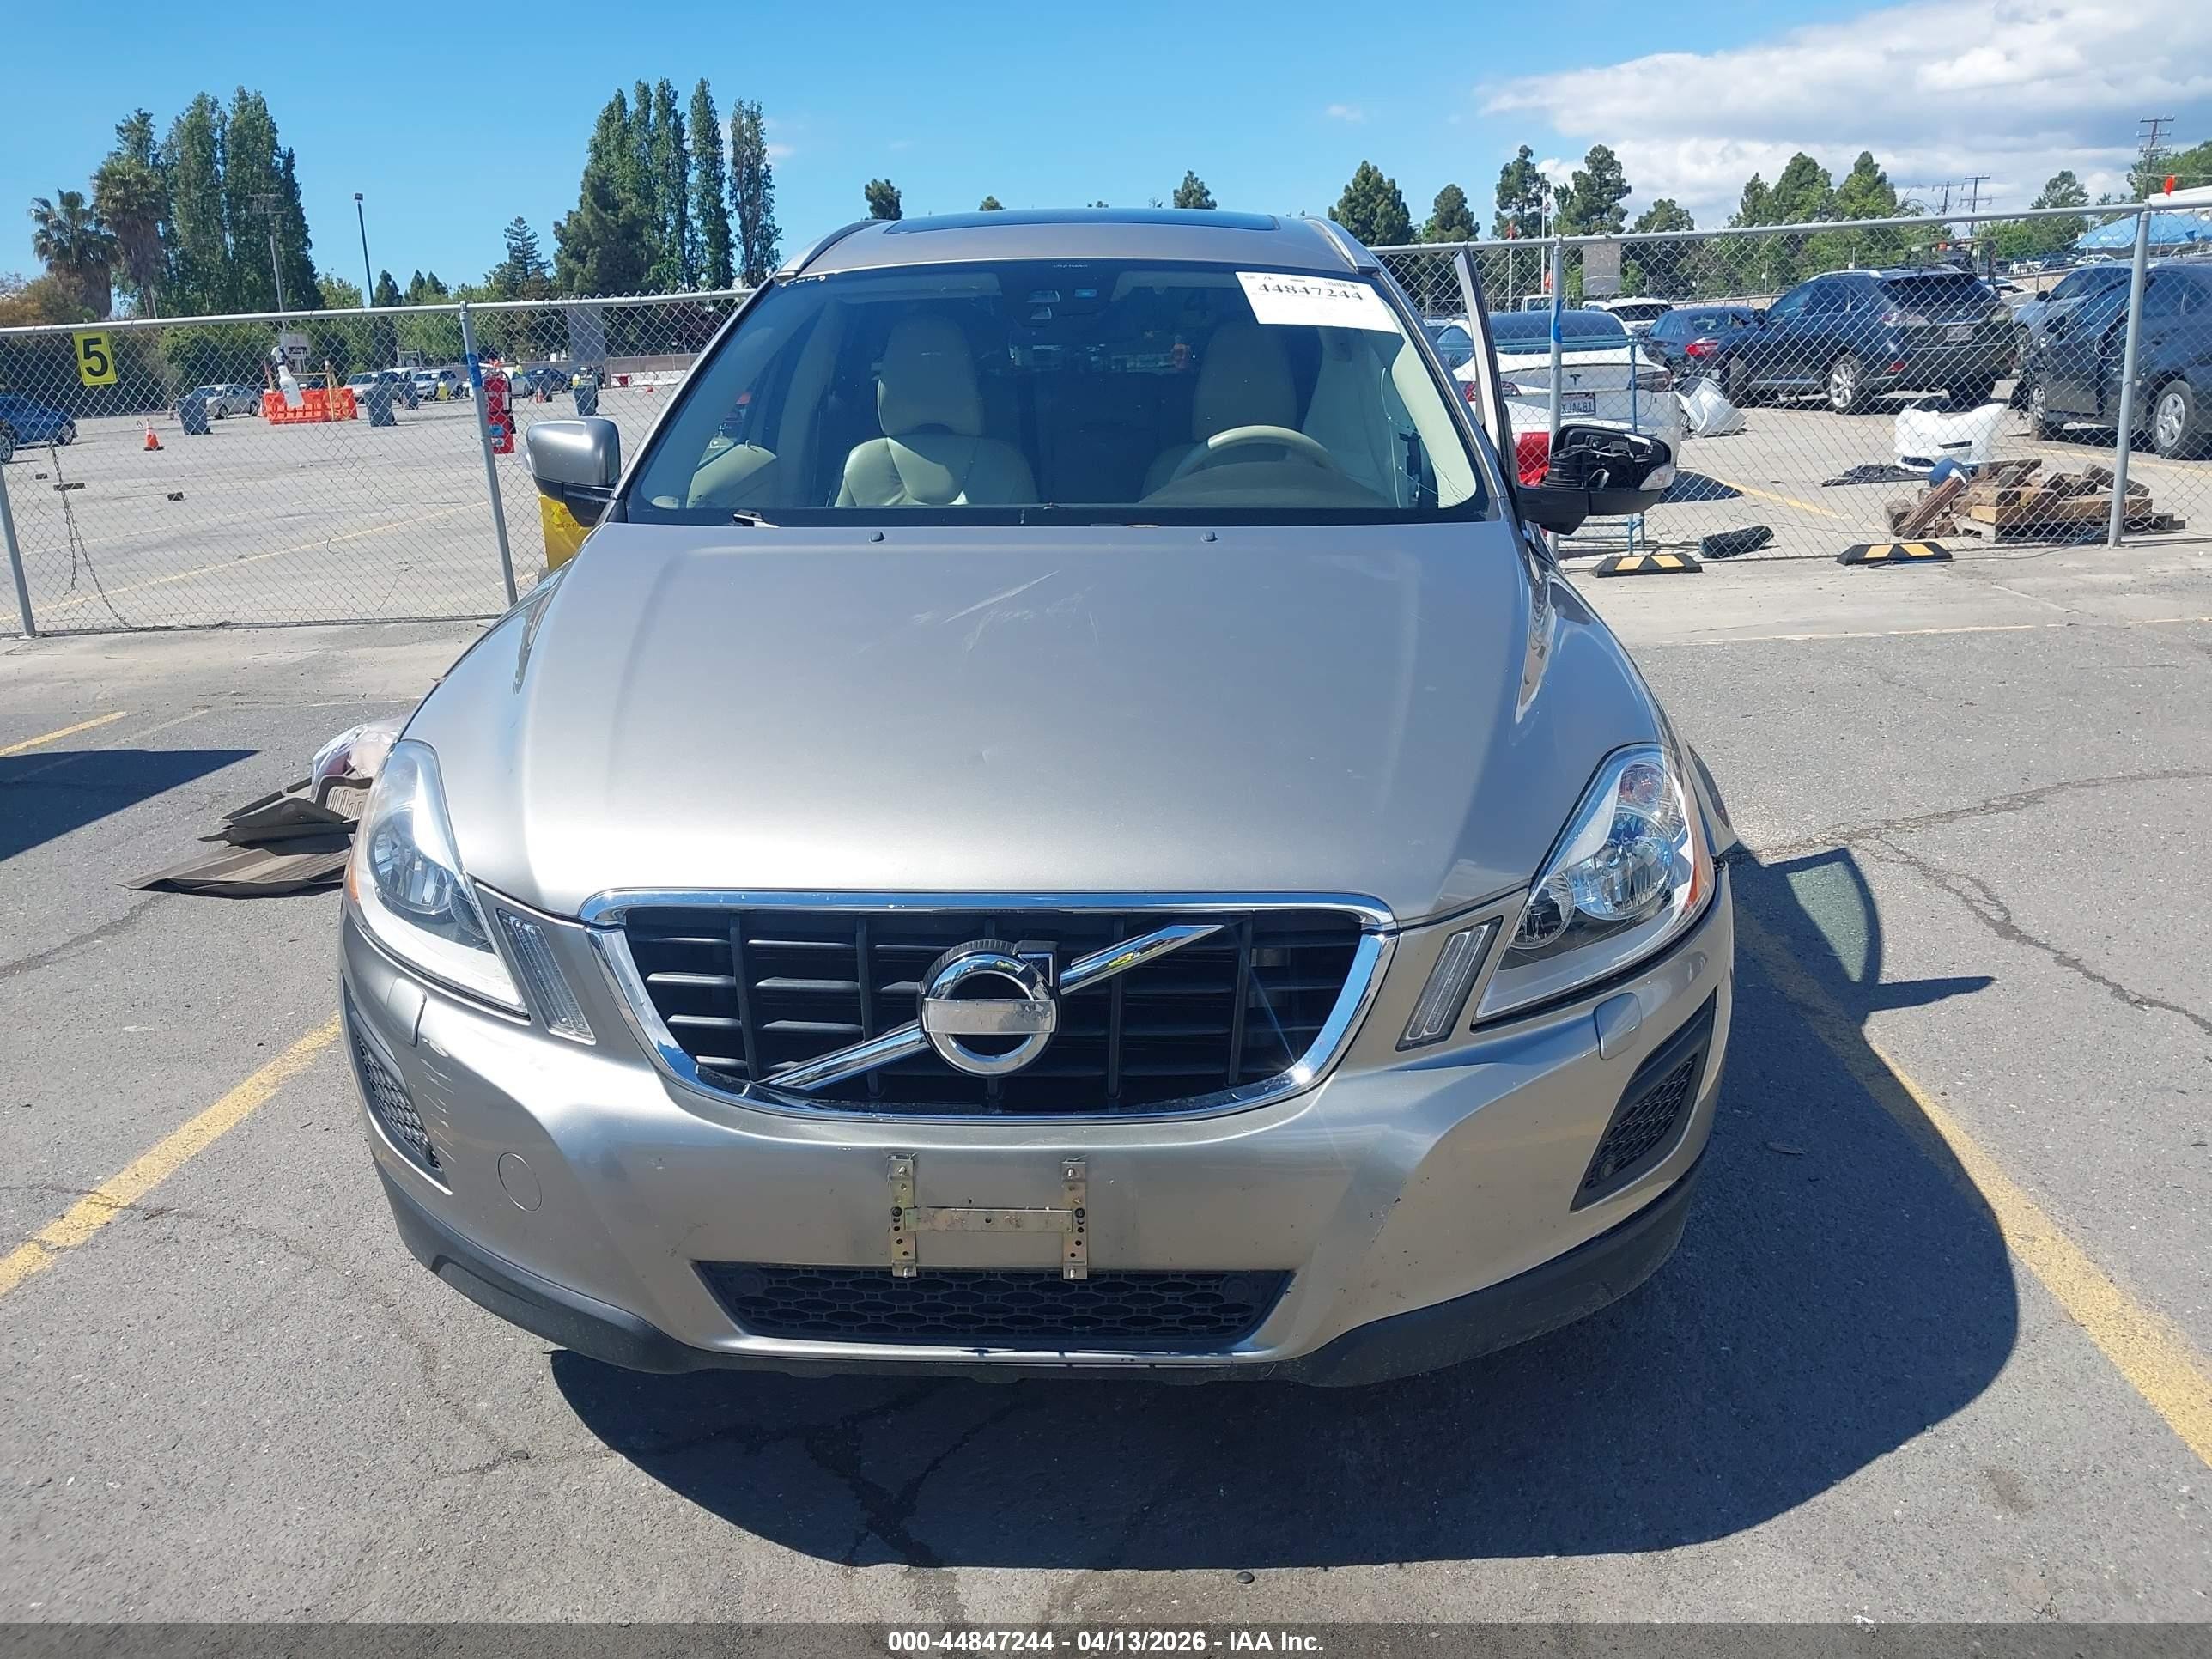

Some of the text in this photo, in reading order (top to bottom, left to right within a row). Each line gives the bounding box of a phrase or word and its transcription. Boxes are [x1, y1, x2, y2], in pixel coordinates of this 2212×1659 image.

[1258, 283, 1364, 301] 44847244
[83, 337, 109, 377] 5
[1561, 402, 1593, 414] XJA481
